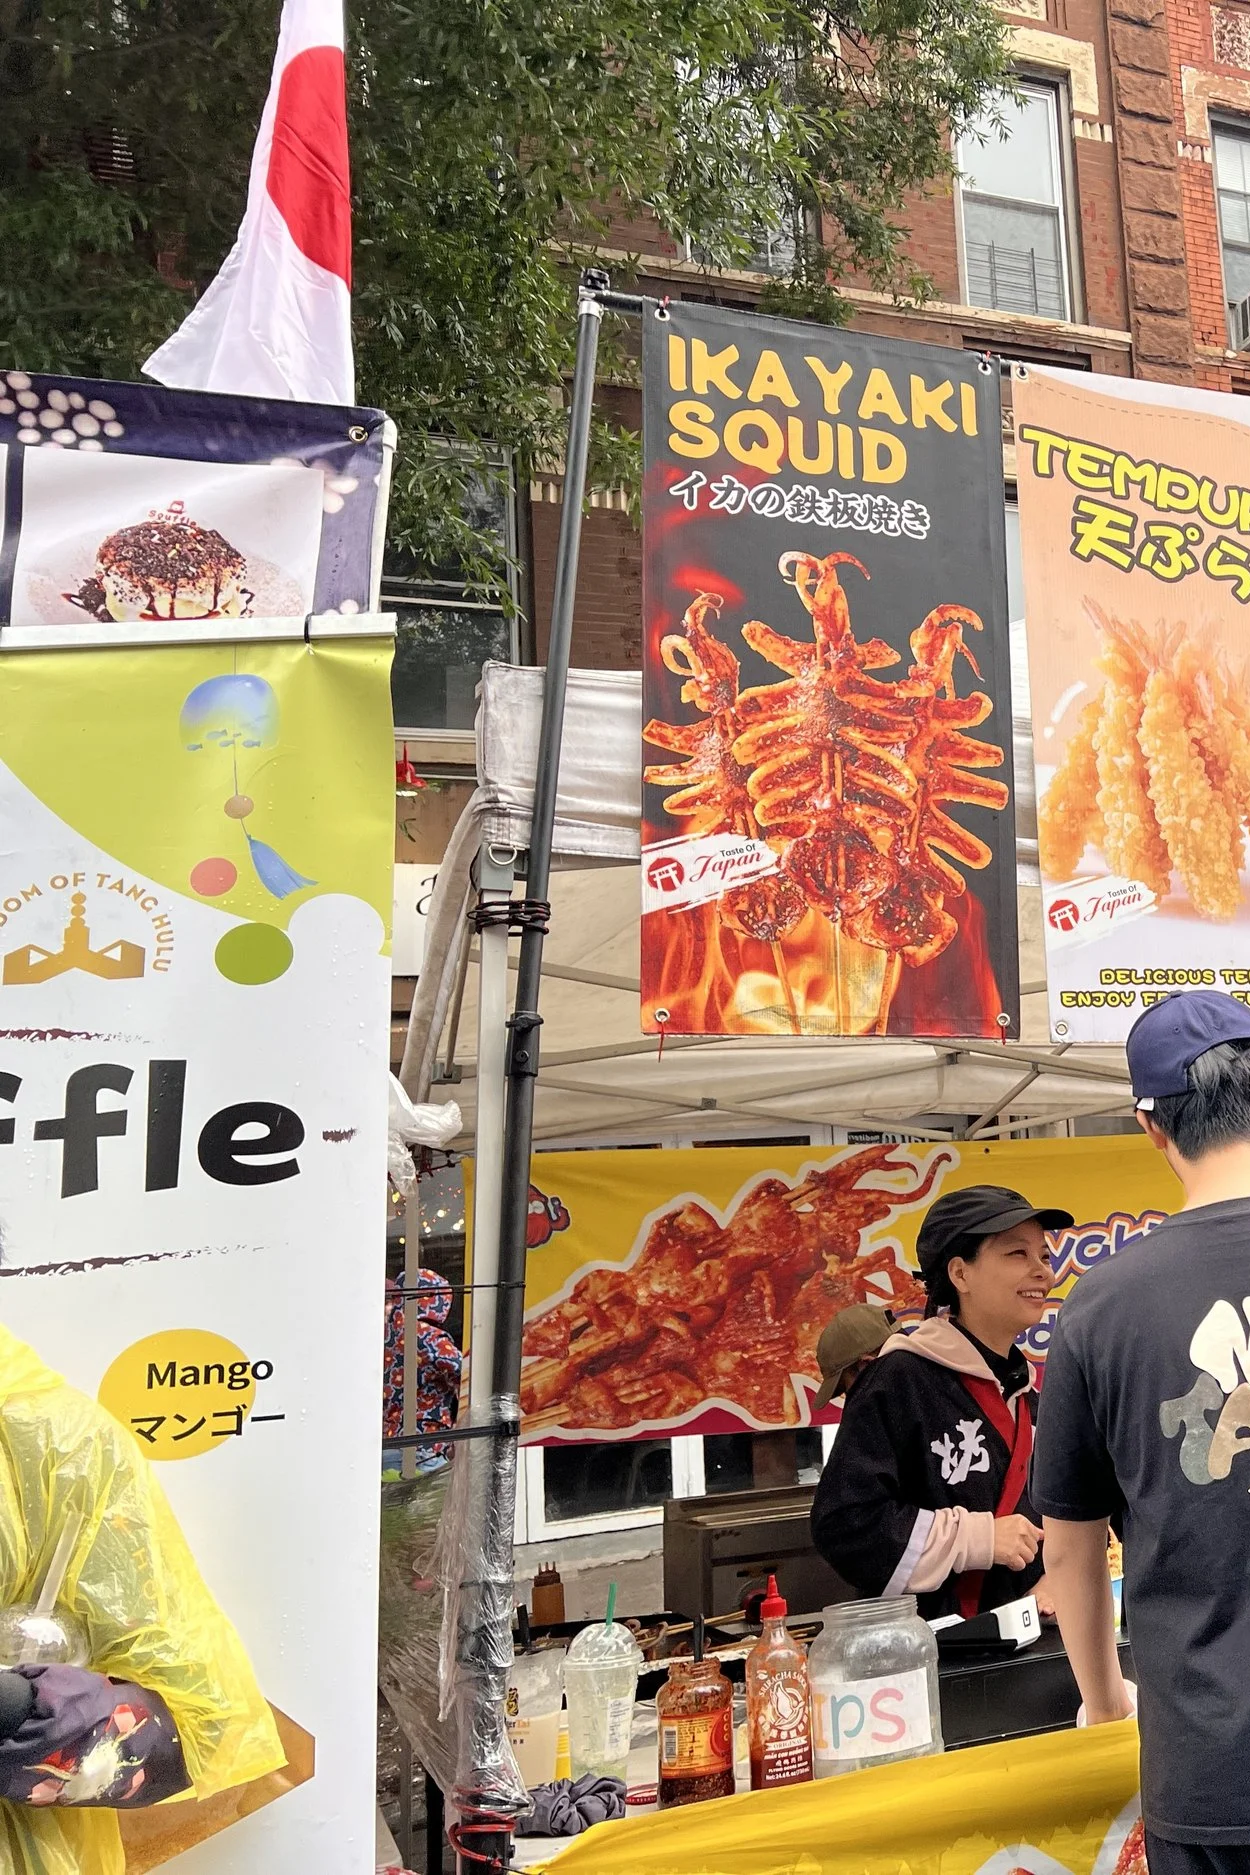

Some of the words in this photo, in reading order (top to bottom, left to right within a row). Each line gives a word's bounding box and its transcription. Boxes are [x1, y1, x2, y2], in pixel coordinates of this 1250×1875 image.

[668, 400, 908, 484] SQUID
[668, 470, 931, 540] イカの鉄板焼き
[720, 847, 744, 858] Taste
[745, 843, 756, 852] Of
[690, 851, 764, 882] Japan
[50, 872, 86, 890] OF
[1107, 888, 1127, 898] Taste
[1128, 884, 1137, 893] Of
[1084, 891, 1143, 921] Japan
[1100, 968, 1216, 985] DELICIOUS
[1060, 991, 1135, 1008] ENJOY
[146, 1359, 274, 1391] Mango
[130, 1404, 285, 1443] マンゴー
[773, 1739, 802, 1749] ORIGINAL
